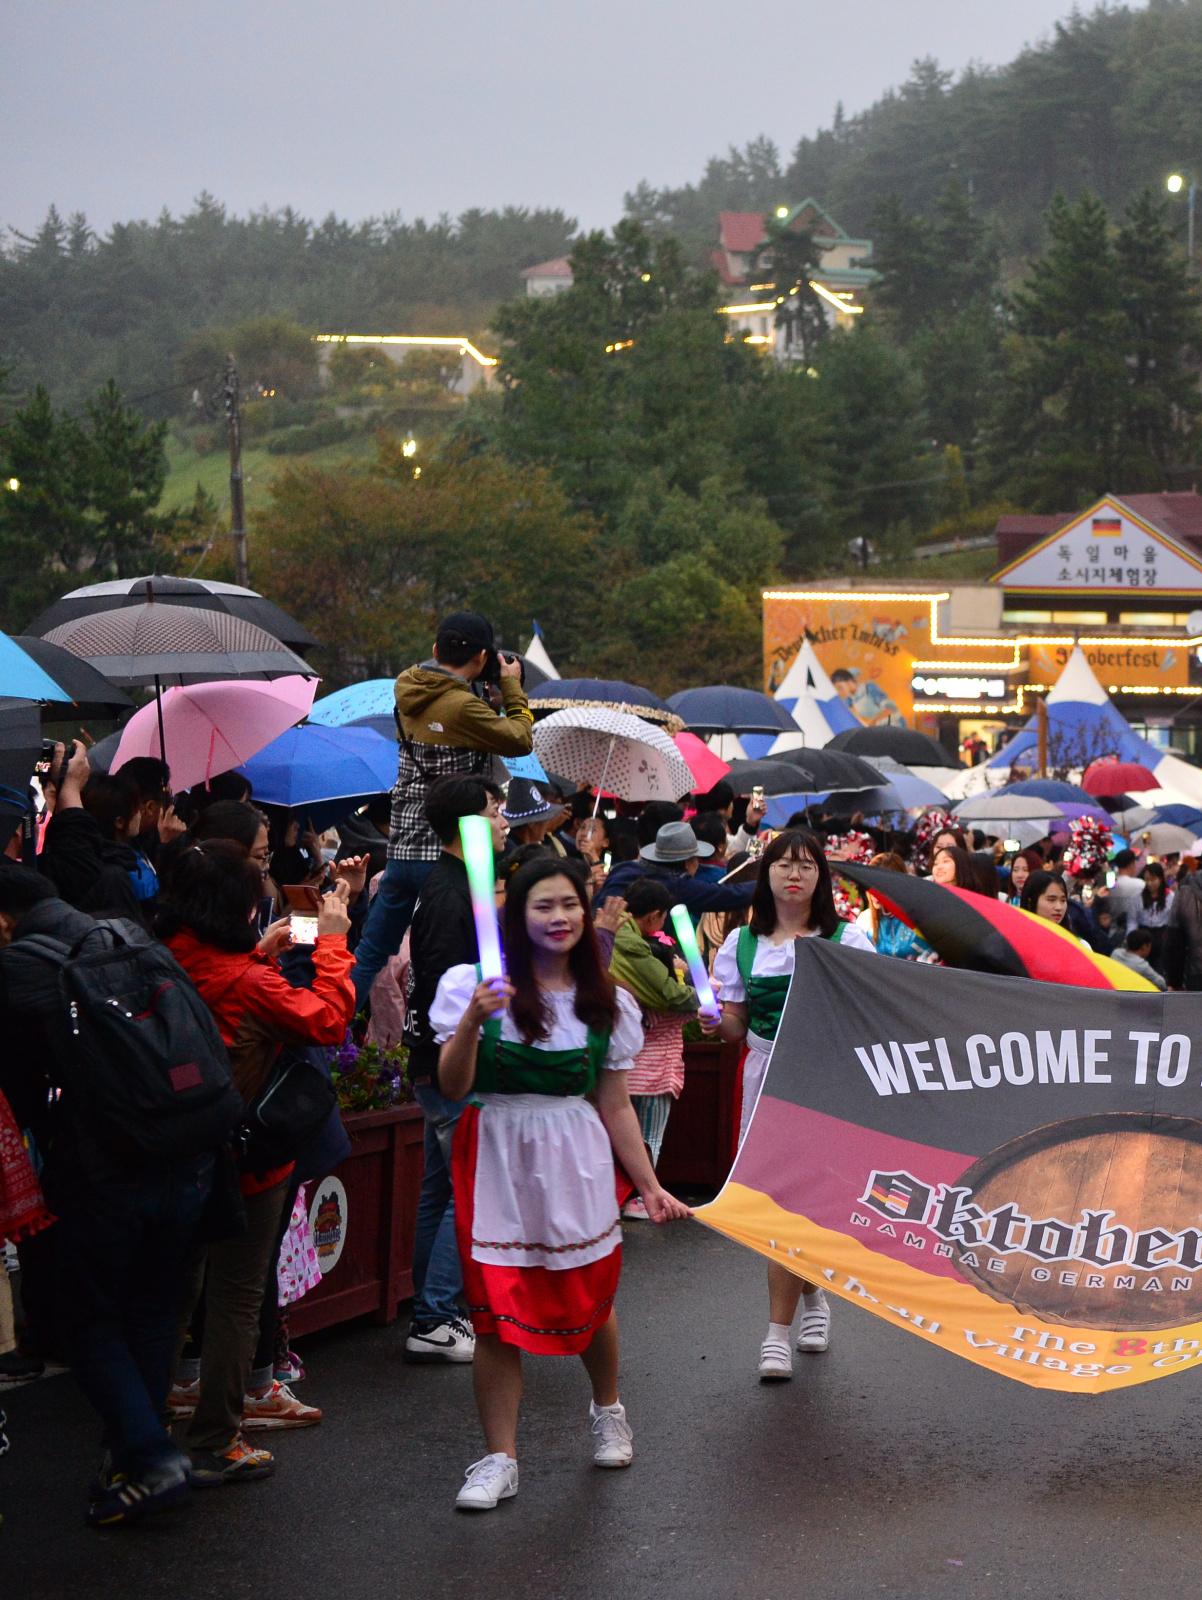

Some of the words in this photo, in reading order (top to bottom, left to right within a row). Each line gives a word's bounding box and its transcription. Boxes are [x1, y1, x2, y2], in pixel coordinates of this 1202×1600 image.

[854, 1029, 1112, 1096] WELCOME
[1128, 1031, 1192, 1087] TO
[850, 1212, 1007, 1273] NAMHAE
[1031, 1268, 1192, 1292] GERMAN
[1006, 1325, 1096, 1354] The
[1115, 1337, 1200, 1357] 8th
